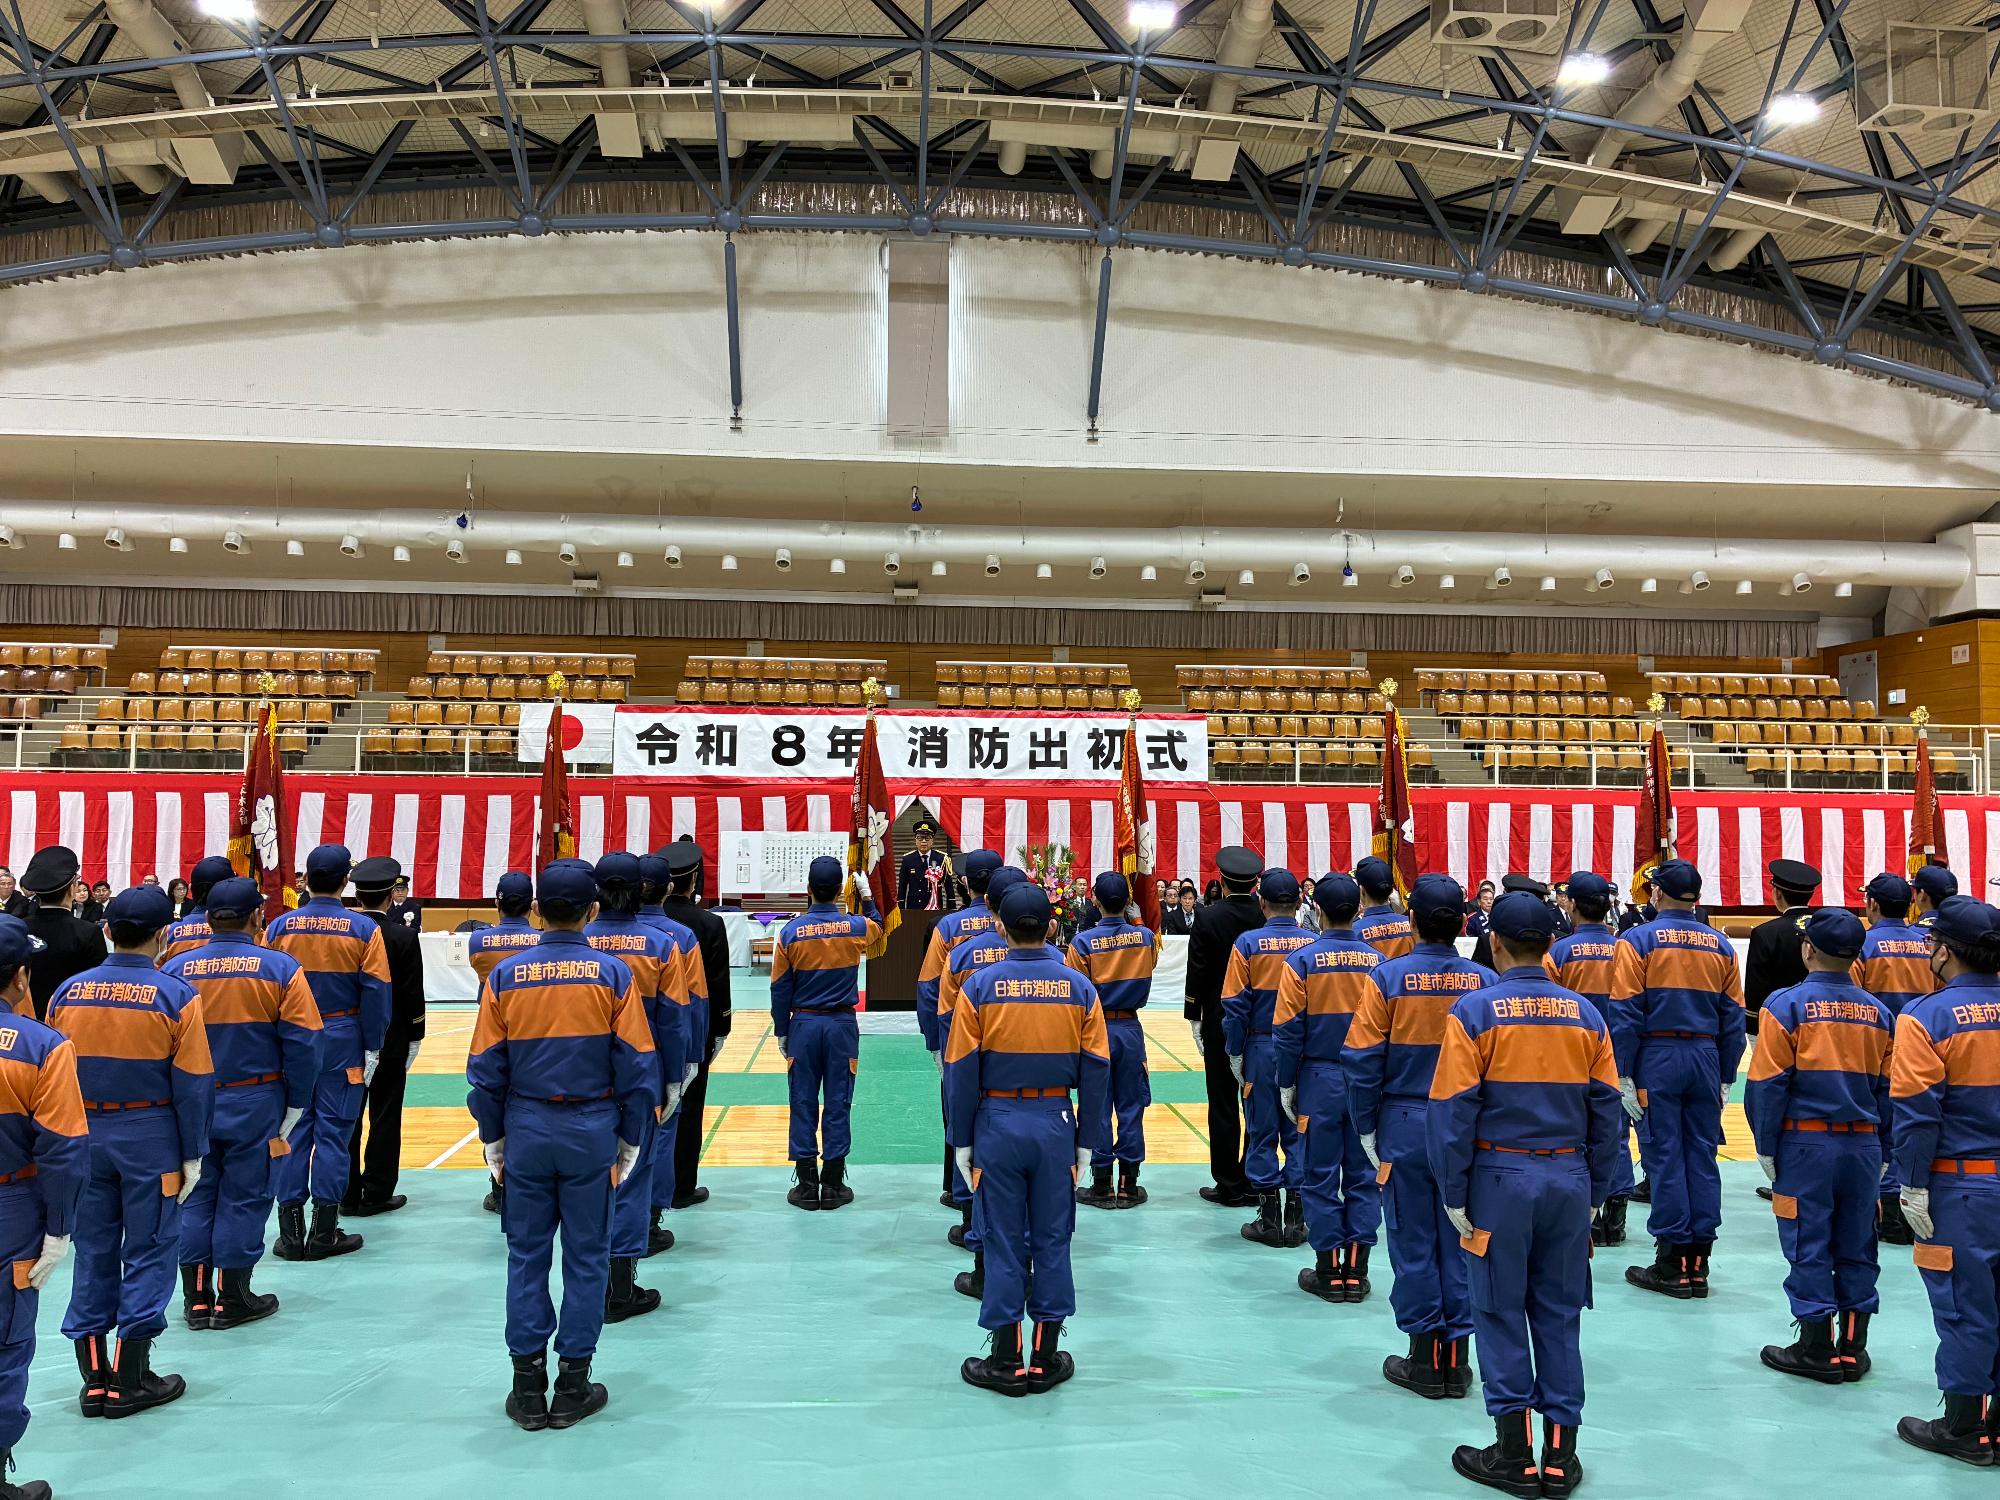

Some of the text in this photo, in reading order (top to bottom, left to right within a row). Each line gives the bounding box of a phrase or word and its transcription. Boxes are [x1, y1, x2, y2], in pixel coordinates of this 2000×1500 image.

[635, 722, 1189, 772] 令和8年 消防出初式
[173, 921, 214, 939] 日進市消
[285, 916, 351, 933] 日進市消防団
[796, 920, 851, 938] 日進市消防団
[960, 915, 995, 931] 日進市
[1362, 920, 1411, 940] 日進市消防団
[482, 934, 541, 948] 日進市消防団
[587, 934, 647, 951] 進市消防団
[1091, 931, 1144, 950] 日進市消防団
[1656, 929, 1719, 949] 日進市消防団
[972, 946, 1009, 964] 日進市
[1315, 950, 1379, 967] 日進市消防団
[1571, 943, 1615, 957] 日進市消
[183, 956, 261, 976] 日進市消防団
[514, 960, 600, 983] 日進市消防団
[995, 978, 1071, 998] 日進市消防団
[1404, 971, 1481, 991] 日進市消防団
[66, 981, 158, 1005] 日進市消防団
[1492, 996, 1581, 1020] 日進市消防団
[1804, 1000, 1879, 1024] 日進市消防団
